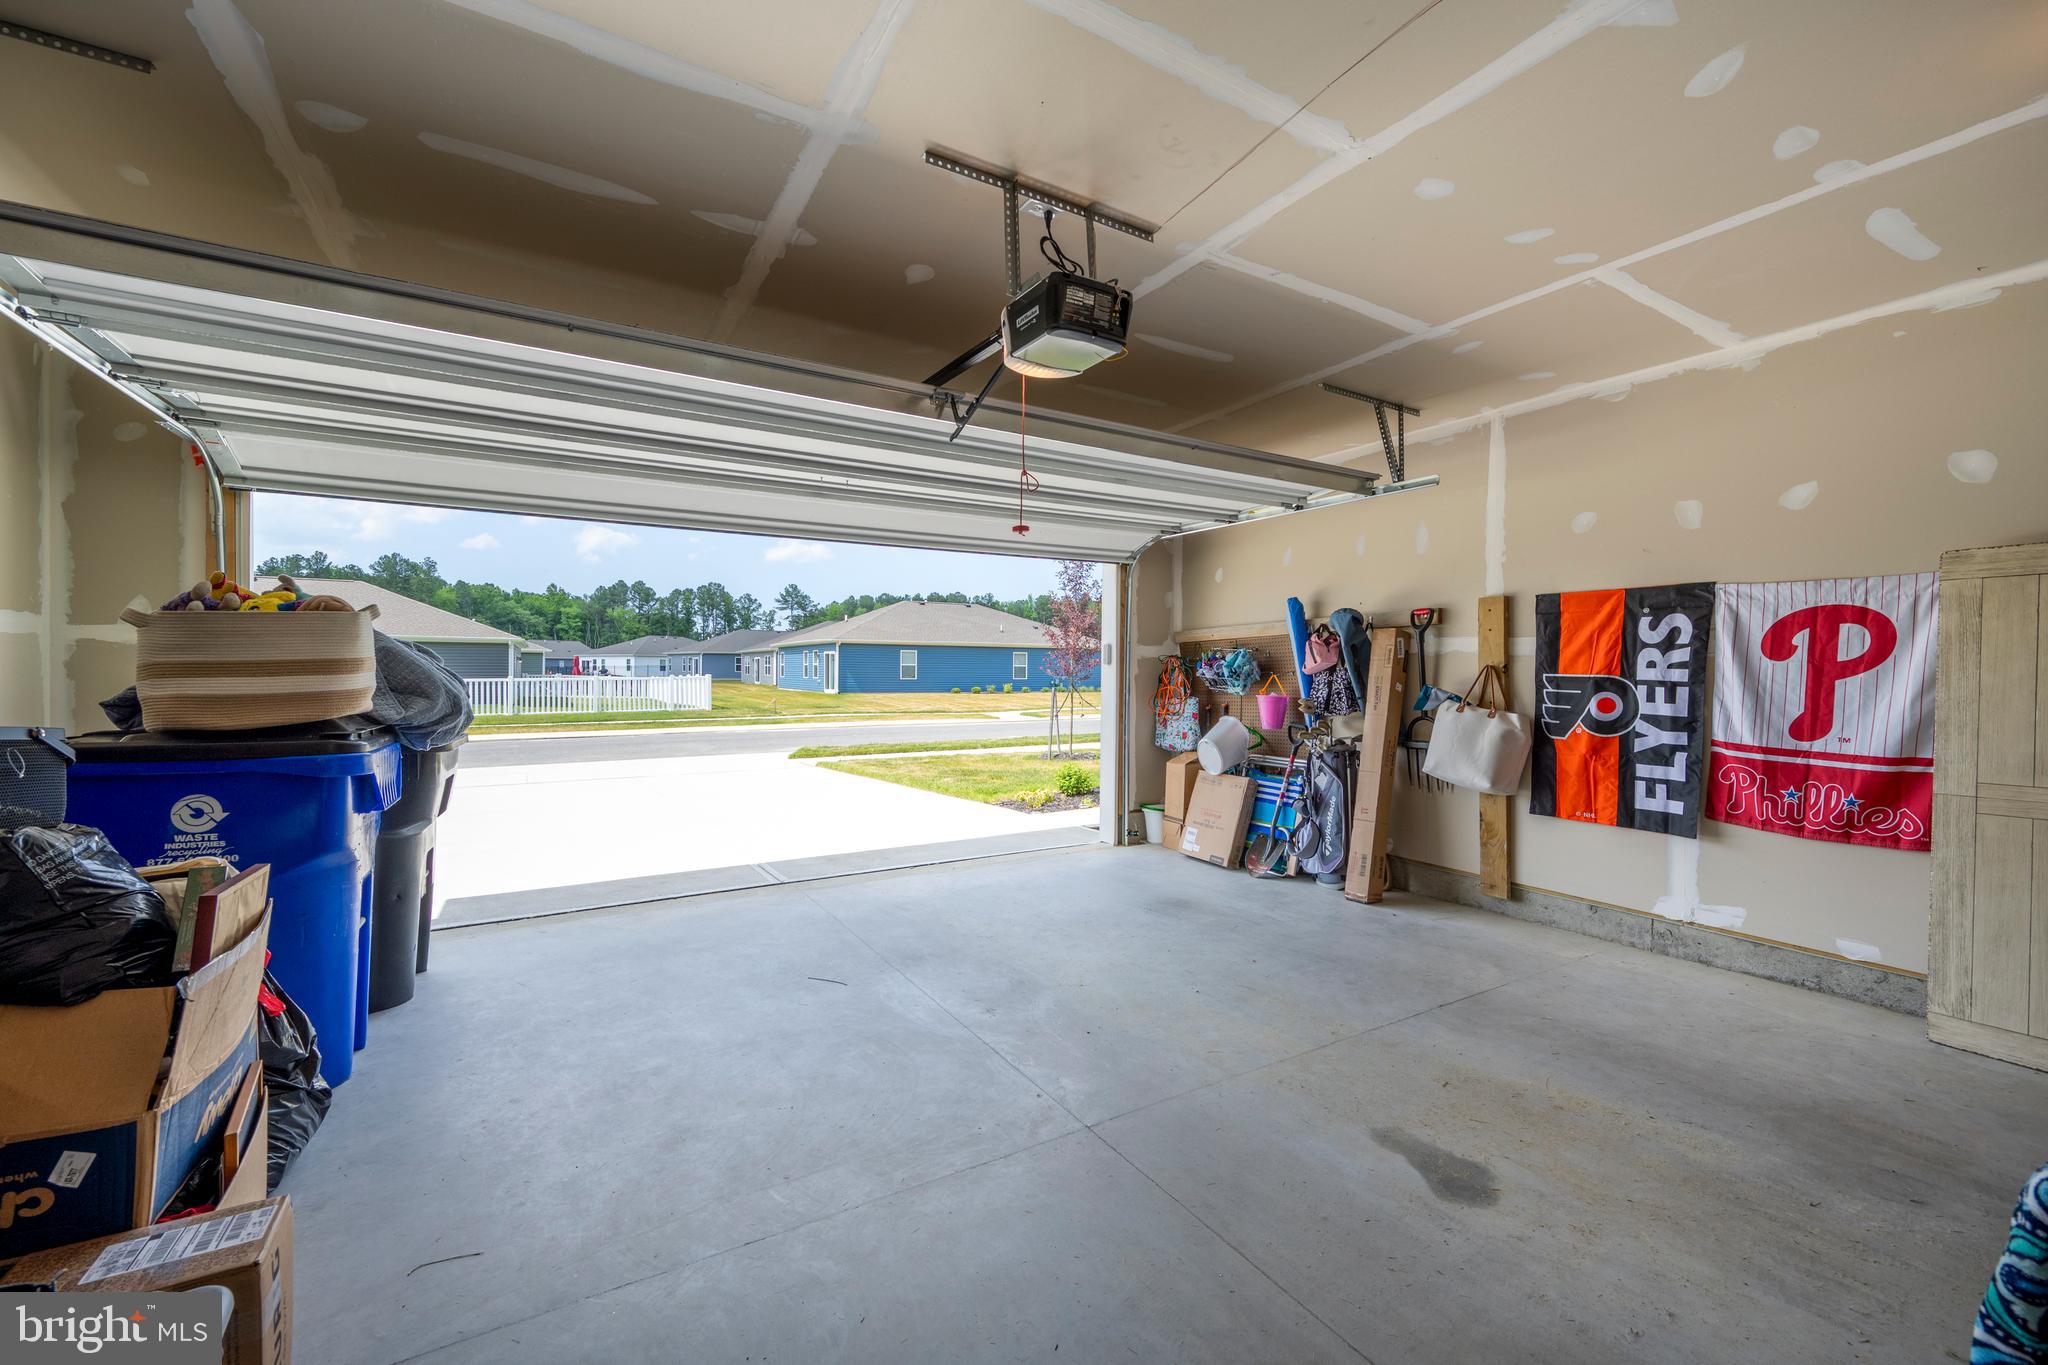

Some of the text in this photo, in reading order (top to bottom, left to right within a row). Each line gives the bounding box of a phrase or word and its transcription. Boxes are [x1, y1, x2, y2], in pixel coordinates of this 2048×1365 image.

[1761, 604, 1897, 742] P
[1634, 613, 1694, 815] FLYERS
[1718, 763, 1924, 840] Phillies
[164, 841, 226, 850] INDUSTRIES
[174, 833, 218, 843] WASTE
[1322, 796, 1337, 857] TaylorMade
[35, 860, 56, 874] BAG
[159, 844, 234, 859] recycling
